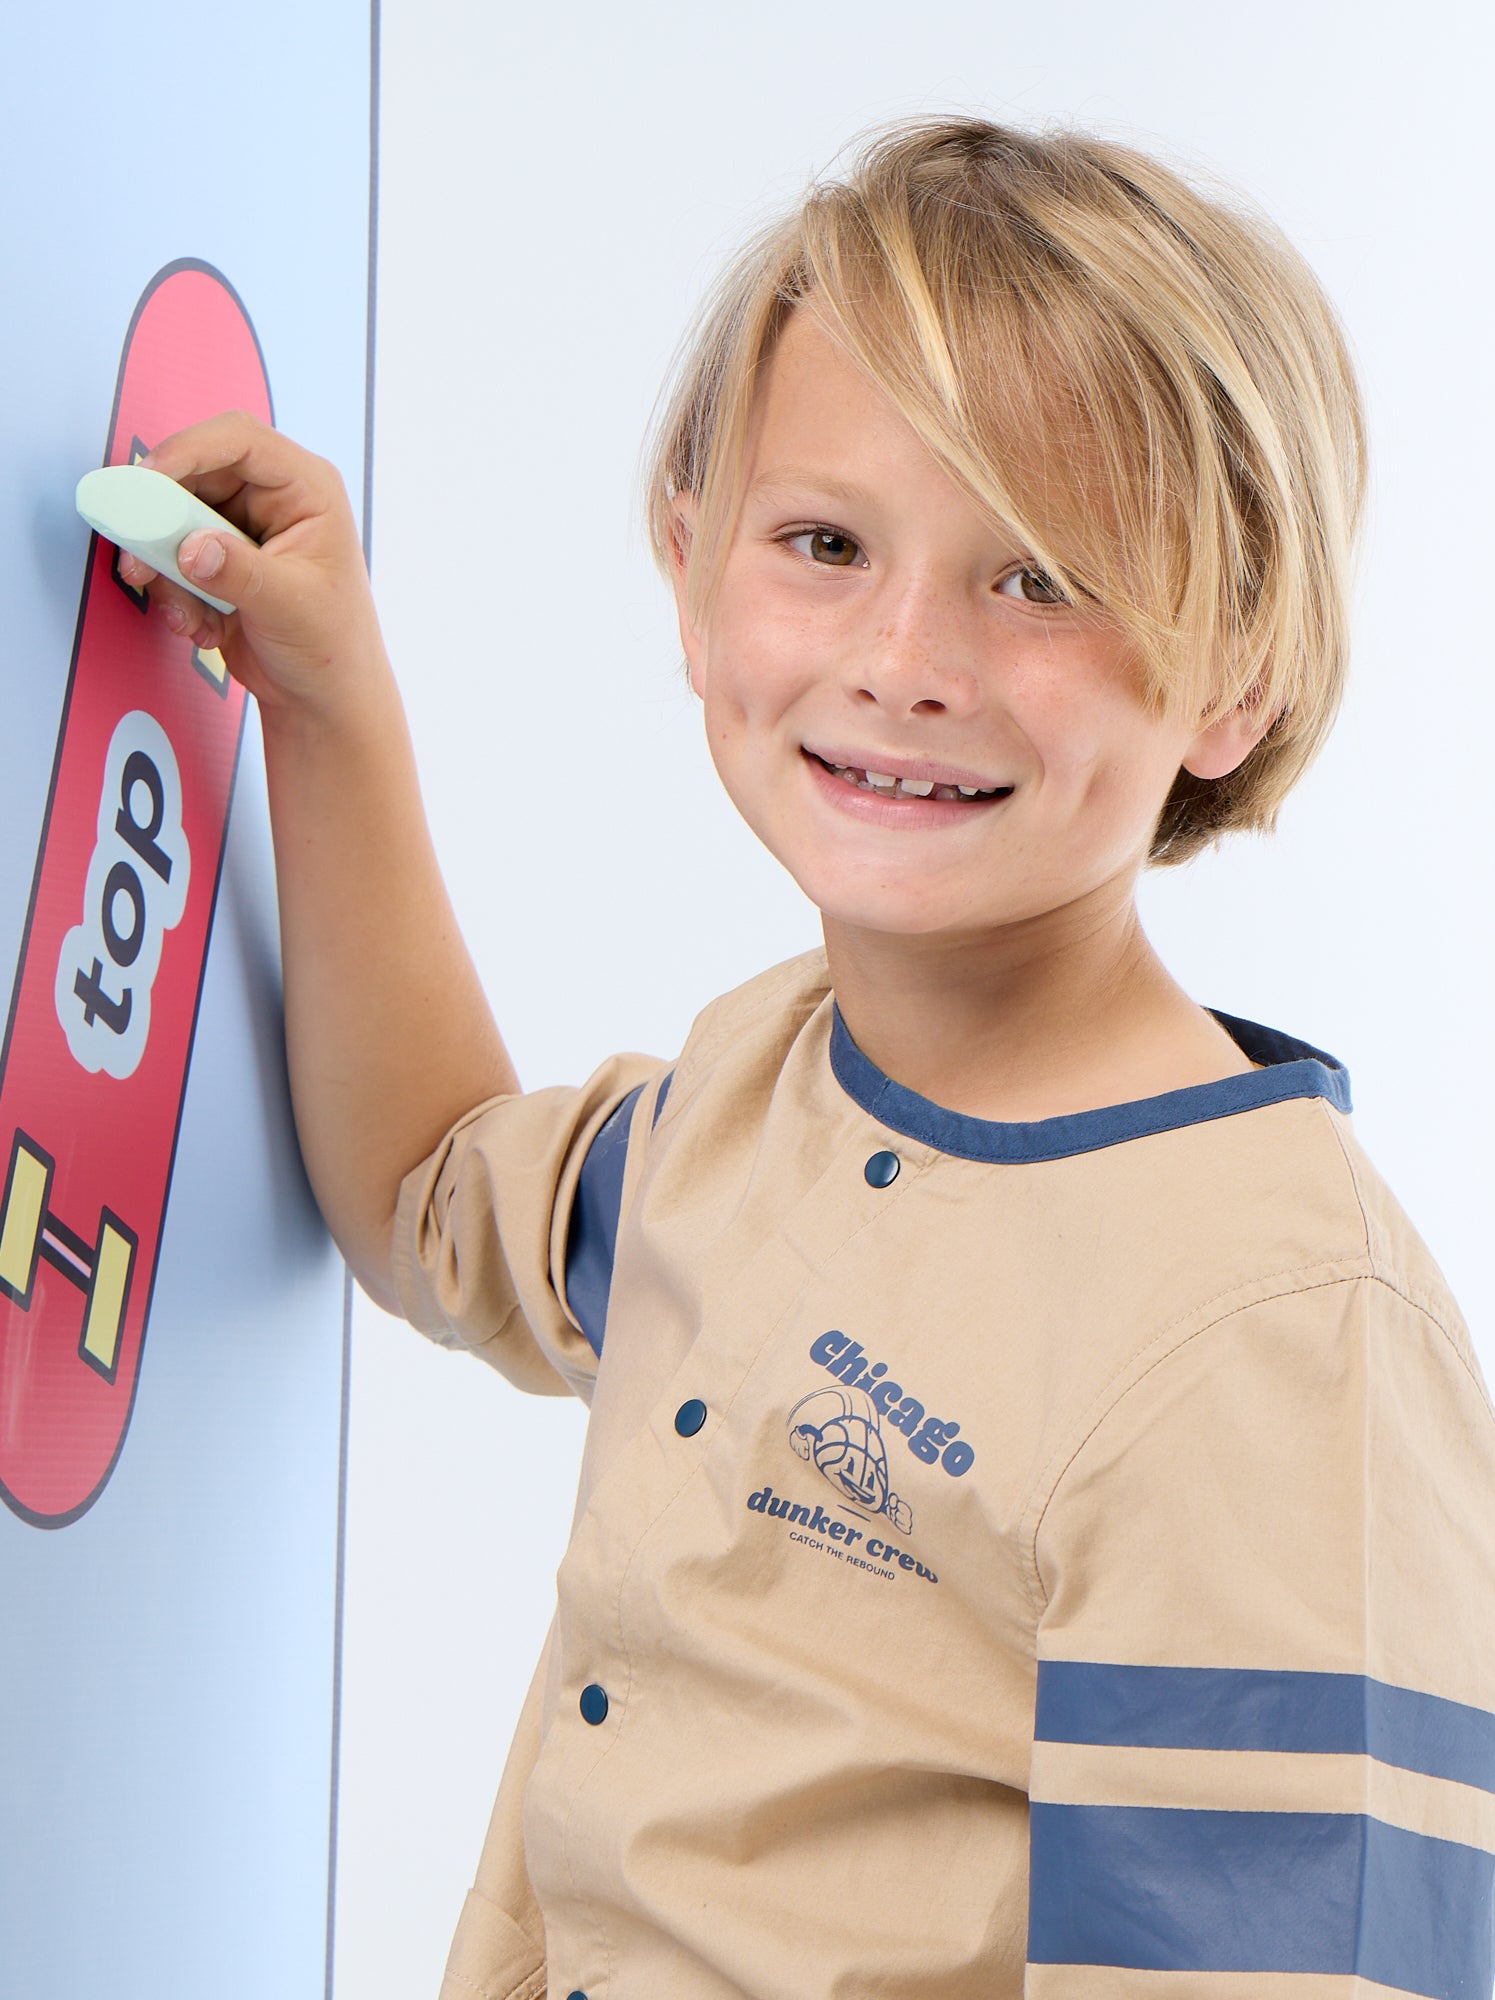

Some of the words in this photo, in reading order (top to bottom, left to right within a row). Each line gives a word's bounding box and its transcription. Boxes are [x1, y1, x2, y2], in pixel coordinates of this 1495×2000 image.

[73, 750, 172, 1035] top
[810, 1330, 975, 1477] Chicago
[747, 1487, 863, 1547] dunker
[865, 1538, 939, 1584] crew
[789, 1531, 824, 1551] CATCH
[826, 1546, 844, 1561] THE
[846, 1555, 896, 1581] REBOUND
